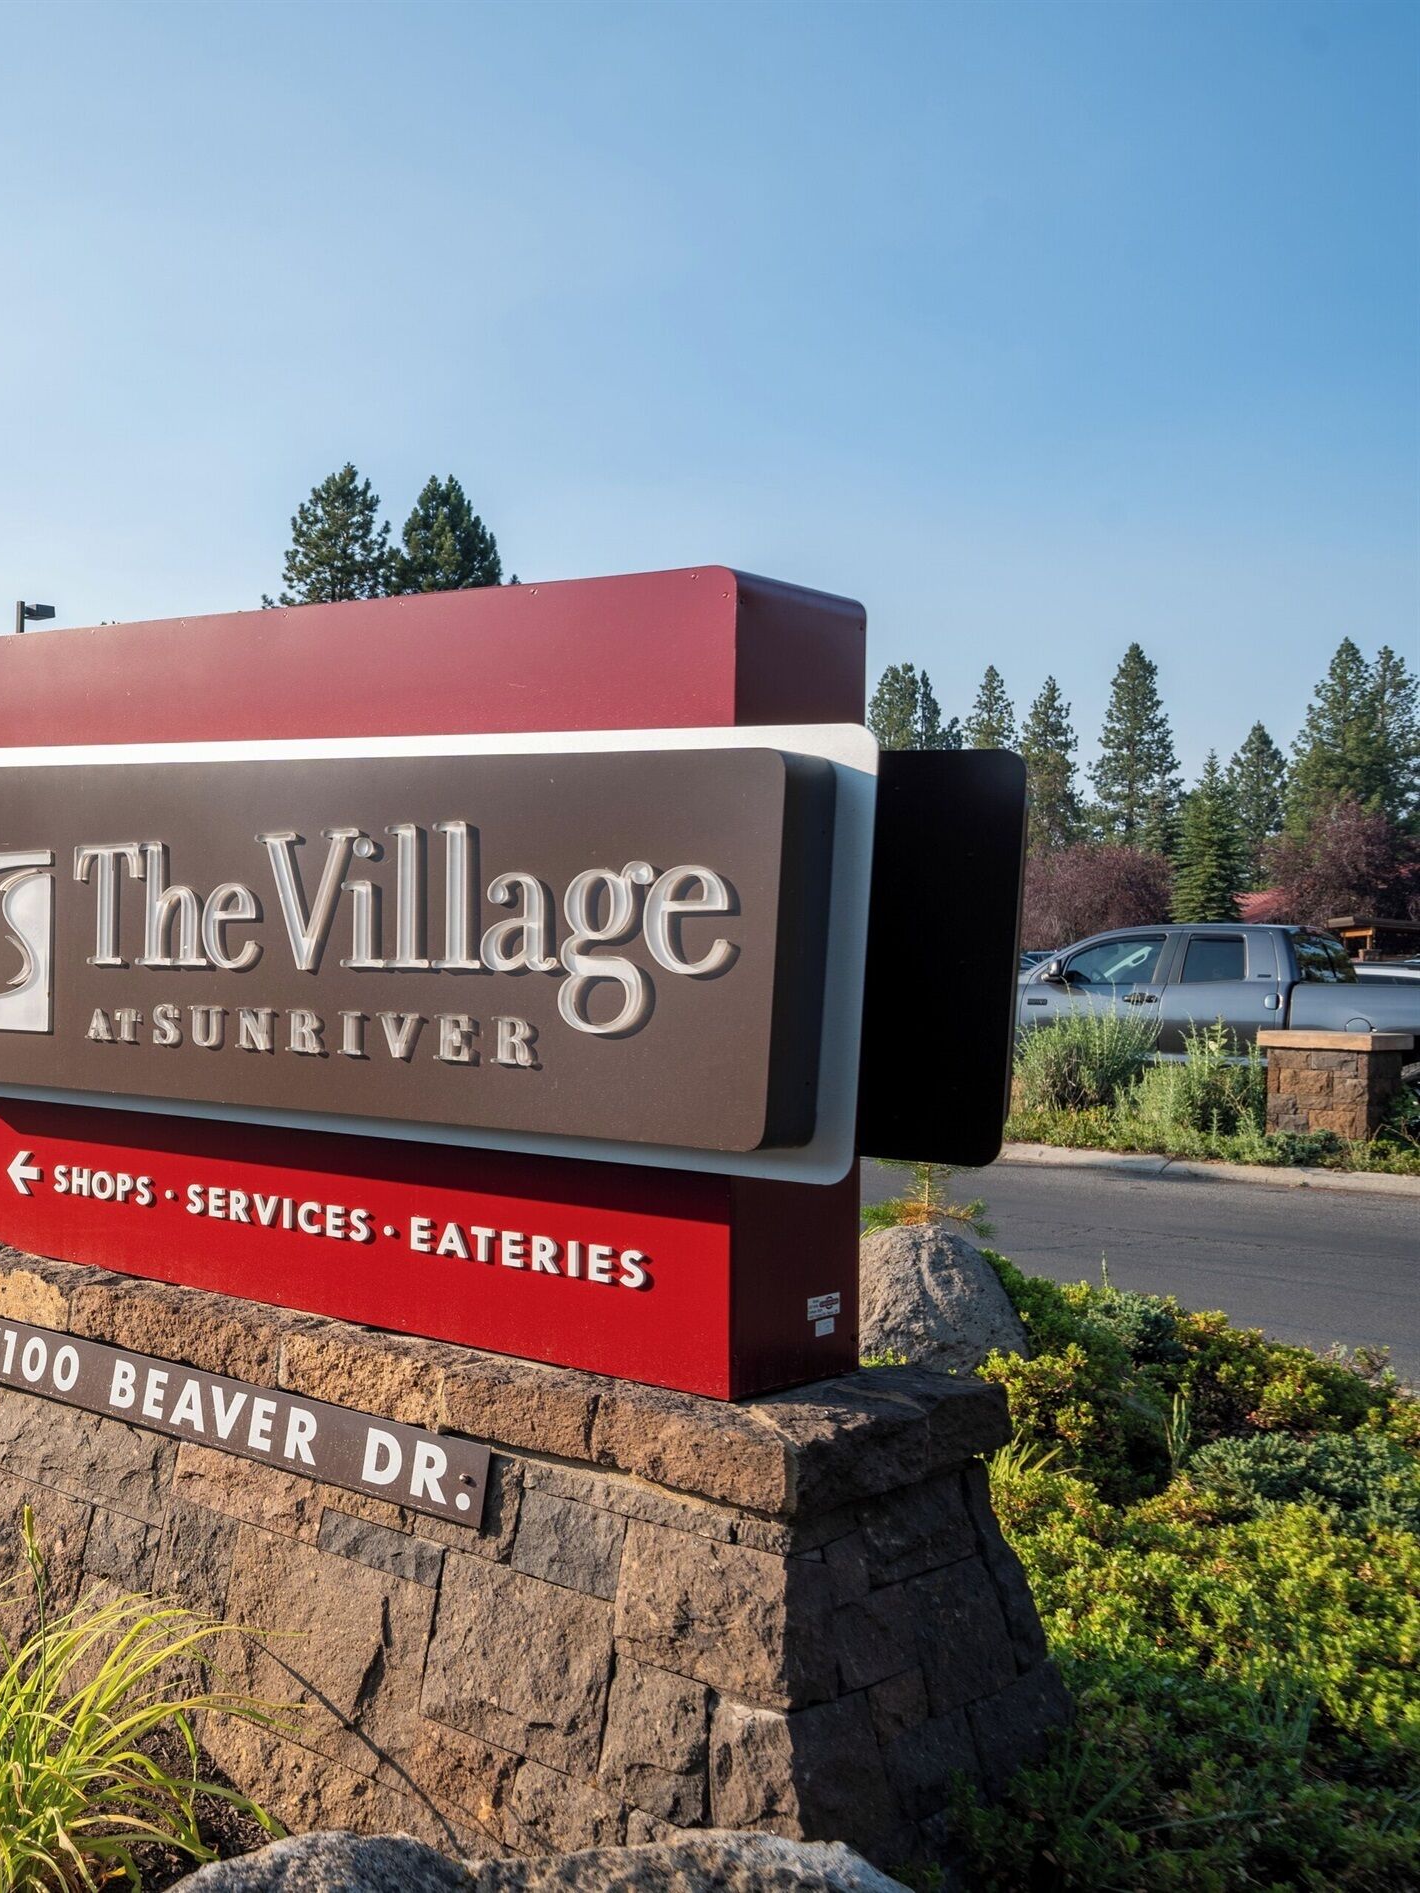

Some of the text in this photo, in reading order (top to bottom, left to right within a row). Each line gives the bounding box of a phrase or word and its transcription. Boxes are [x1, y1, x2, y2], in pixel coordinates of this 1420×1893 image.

[73, 820, 733, 1034] The Village
[85, 1003, 541, 1069] AT SUNRIVER
[53, 1164, 648, 1289] SHOPS SERVICES EATERIES
[108, 1358, 319, 1466] BEAVER
[360, 1427, 471, 1512] DR.
